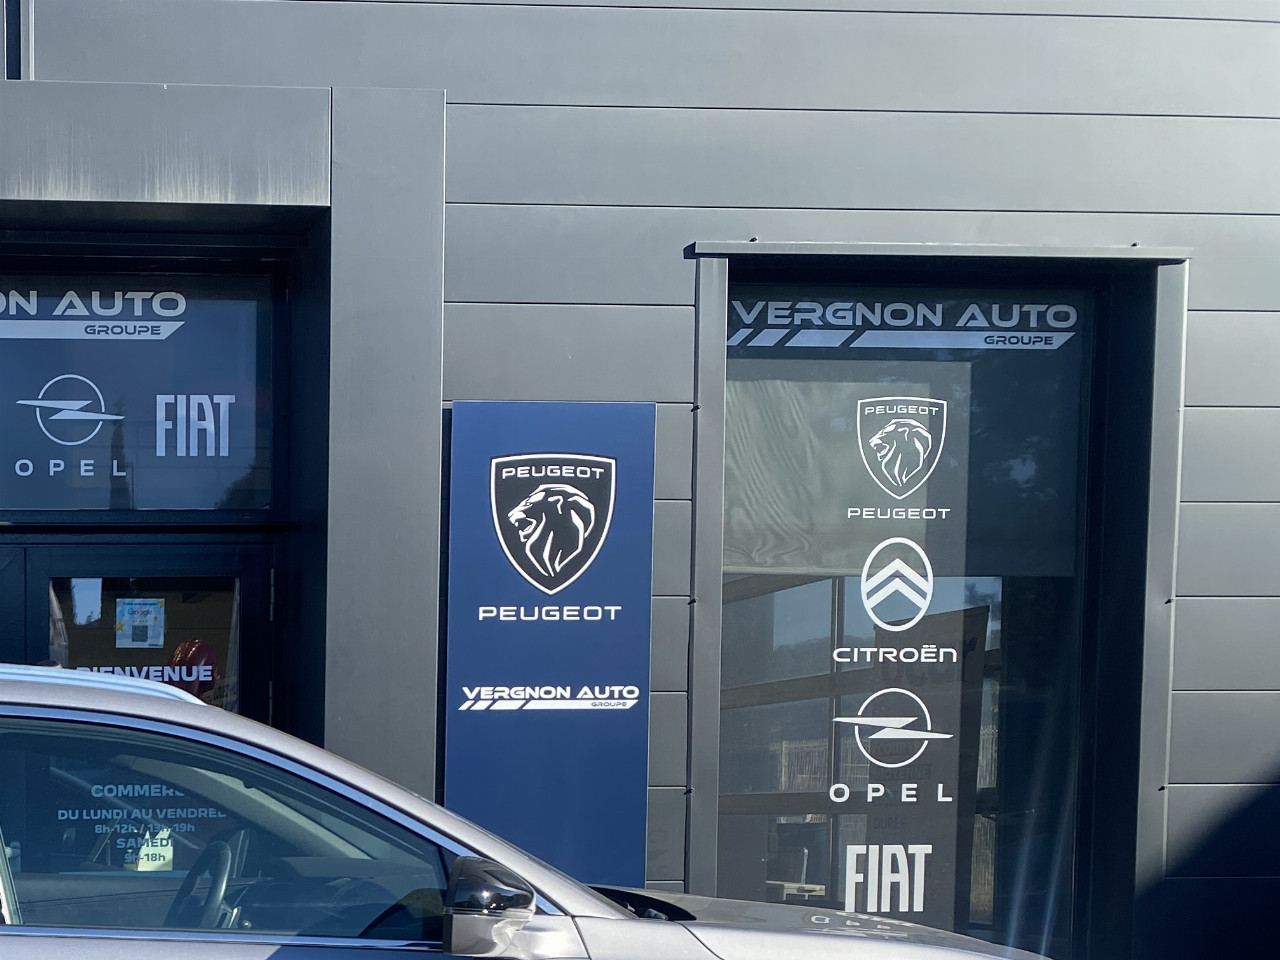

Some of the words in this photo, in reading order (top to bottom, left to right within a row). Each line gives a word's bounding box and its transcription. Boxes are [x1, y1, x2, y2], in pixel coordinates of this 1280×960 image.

[53, 290, 187, 317] AUTO
[733, 300, 942, 327] VERGNON
[955, 303, 1078, 328] AUTO
[84, 323, 163, 335] GROUPE
[983, 335, 1054, 346] GROUPE
[864, 405, 939, 416] PEUGEOT
[156, 394, 236, 457] FIAT
[502, 465, 605, 480] PEUGEOT
[848, 507, 951, 520] PEUGEOT
[479, 605, 622, 621] PEUGEOT
[462, 685, 571, 700] VERGNON
[576, 685, 640, 700] AUTO
[58, 809, 79, 820] DU
[83, 809, 127, 820] LUNDI
[131, 808, 153, 819] AU
[116, 838, 173, 849] SAMEDI
[845, 844, 933, 914] FIAT
